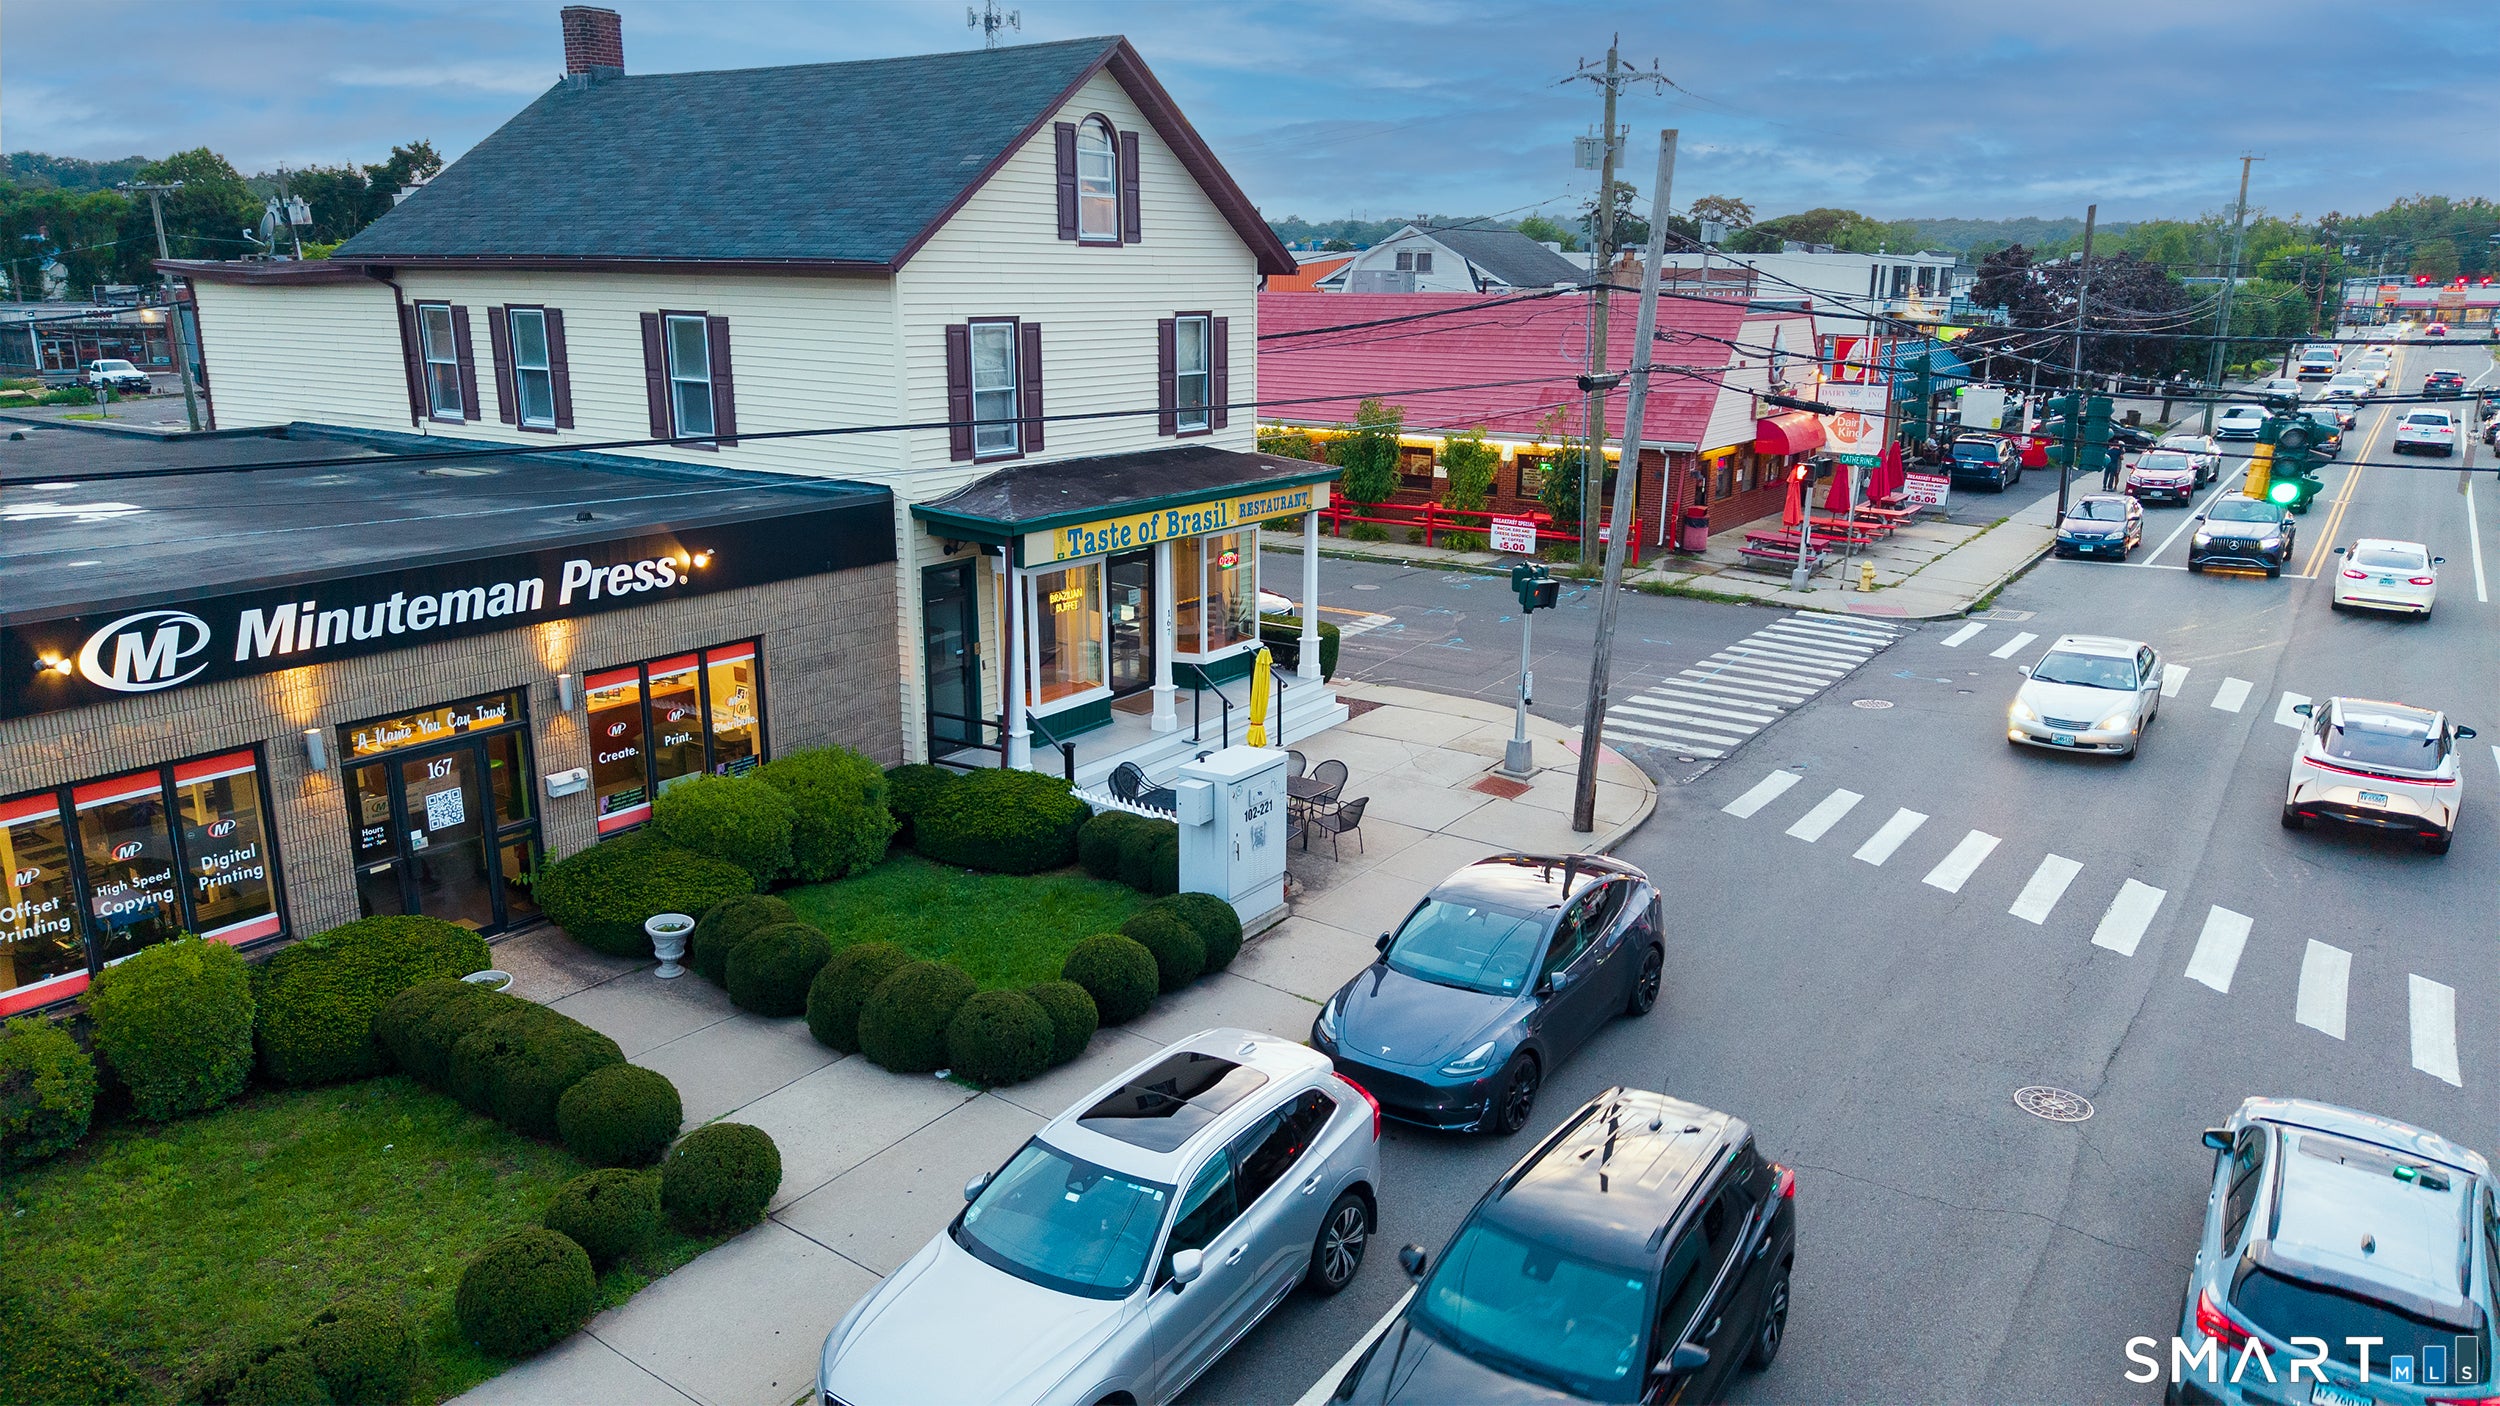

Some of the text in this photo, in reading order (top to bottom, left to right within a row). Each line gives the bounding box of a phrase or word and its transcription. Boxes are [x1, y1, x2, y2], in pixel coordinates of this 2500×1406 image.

[1821, 389, 1845, 397] DAIRY
[1837, 416, 1860, 427] Dair
[1841, 455, 1874, 466] CATHERINE
[1911, 495, 1937, 504] $5.00
[1067, 492, 1308, 556] Taste of Brasil RESTAURANT
[1500, 542, 1525, 552] $5.00
[1219, 553, 1238, 565] OPEN
[1050, 588, 1083, 603] BRAZILIAN
[1056, 600, 1078, 613] BUFFET
[235, 576, 544, 662] Minuteman
[357, 703, 507, 750] A Name You Can Trust
[427, 758, 452, 779] 167
[1244, 799, 1273, 822] 102-221
[362, 826, 384, 836] Hours
[201, 843, 256, 870] Digital
[97, 868, 171, 897] High Speed
[199, 866, 264, 891] Printing
[0, 897, 59, 923] Offset
[100, 888, 174, 916] Copying
